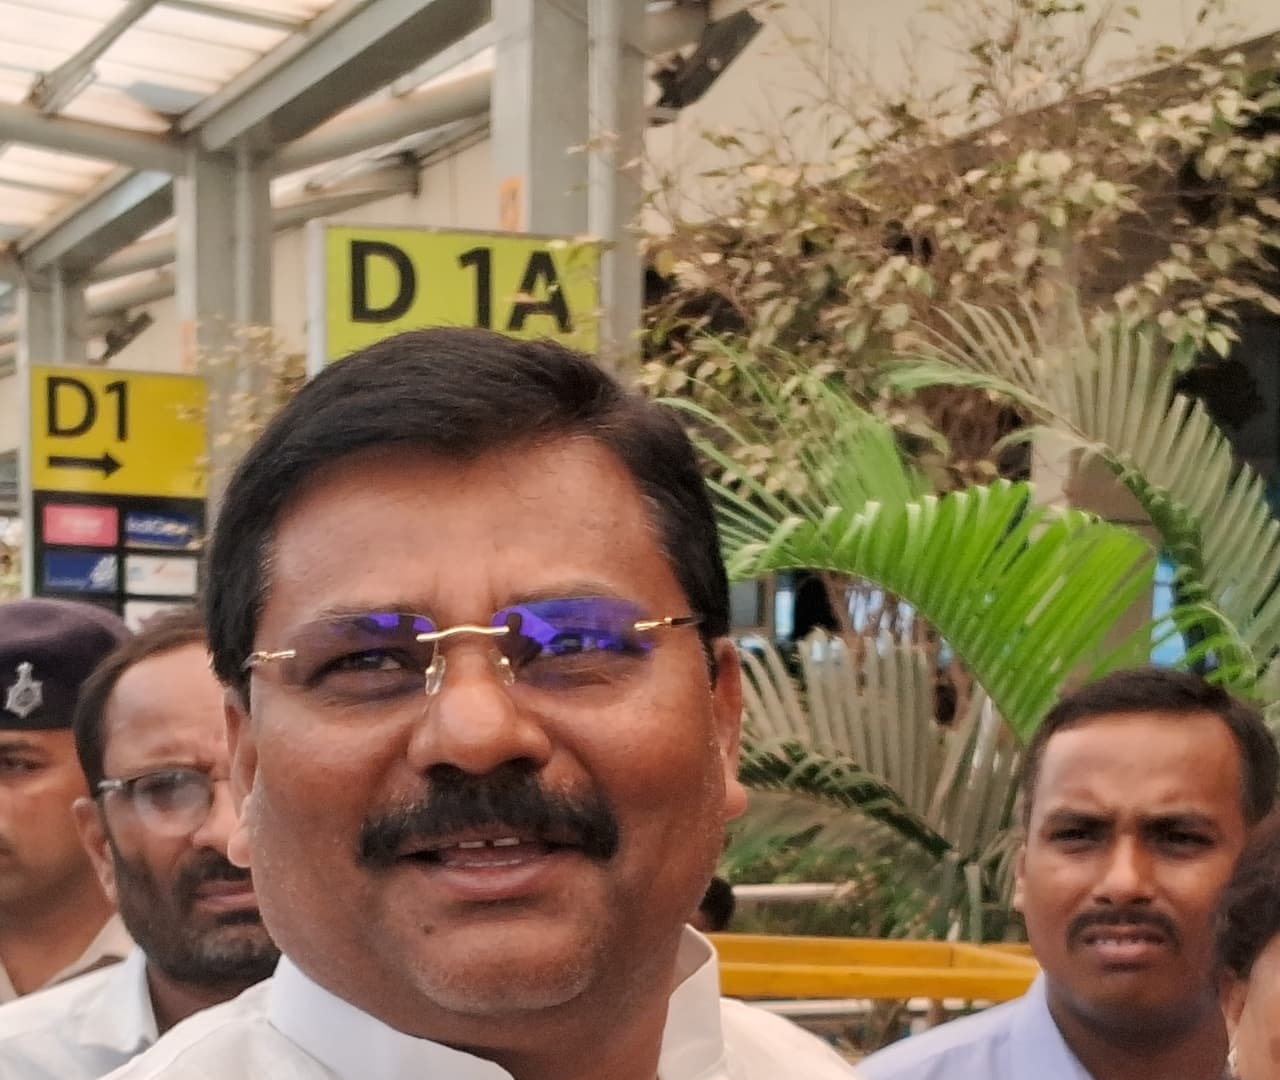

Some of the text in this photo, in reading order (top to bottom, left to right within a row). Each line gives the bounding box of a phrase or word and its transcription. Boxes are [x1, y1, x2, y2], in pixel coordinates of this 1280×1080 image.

[350, 240, 573, 335] D 1A
[46, 377, 129, 442] D1
